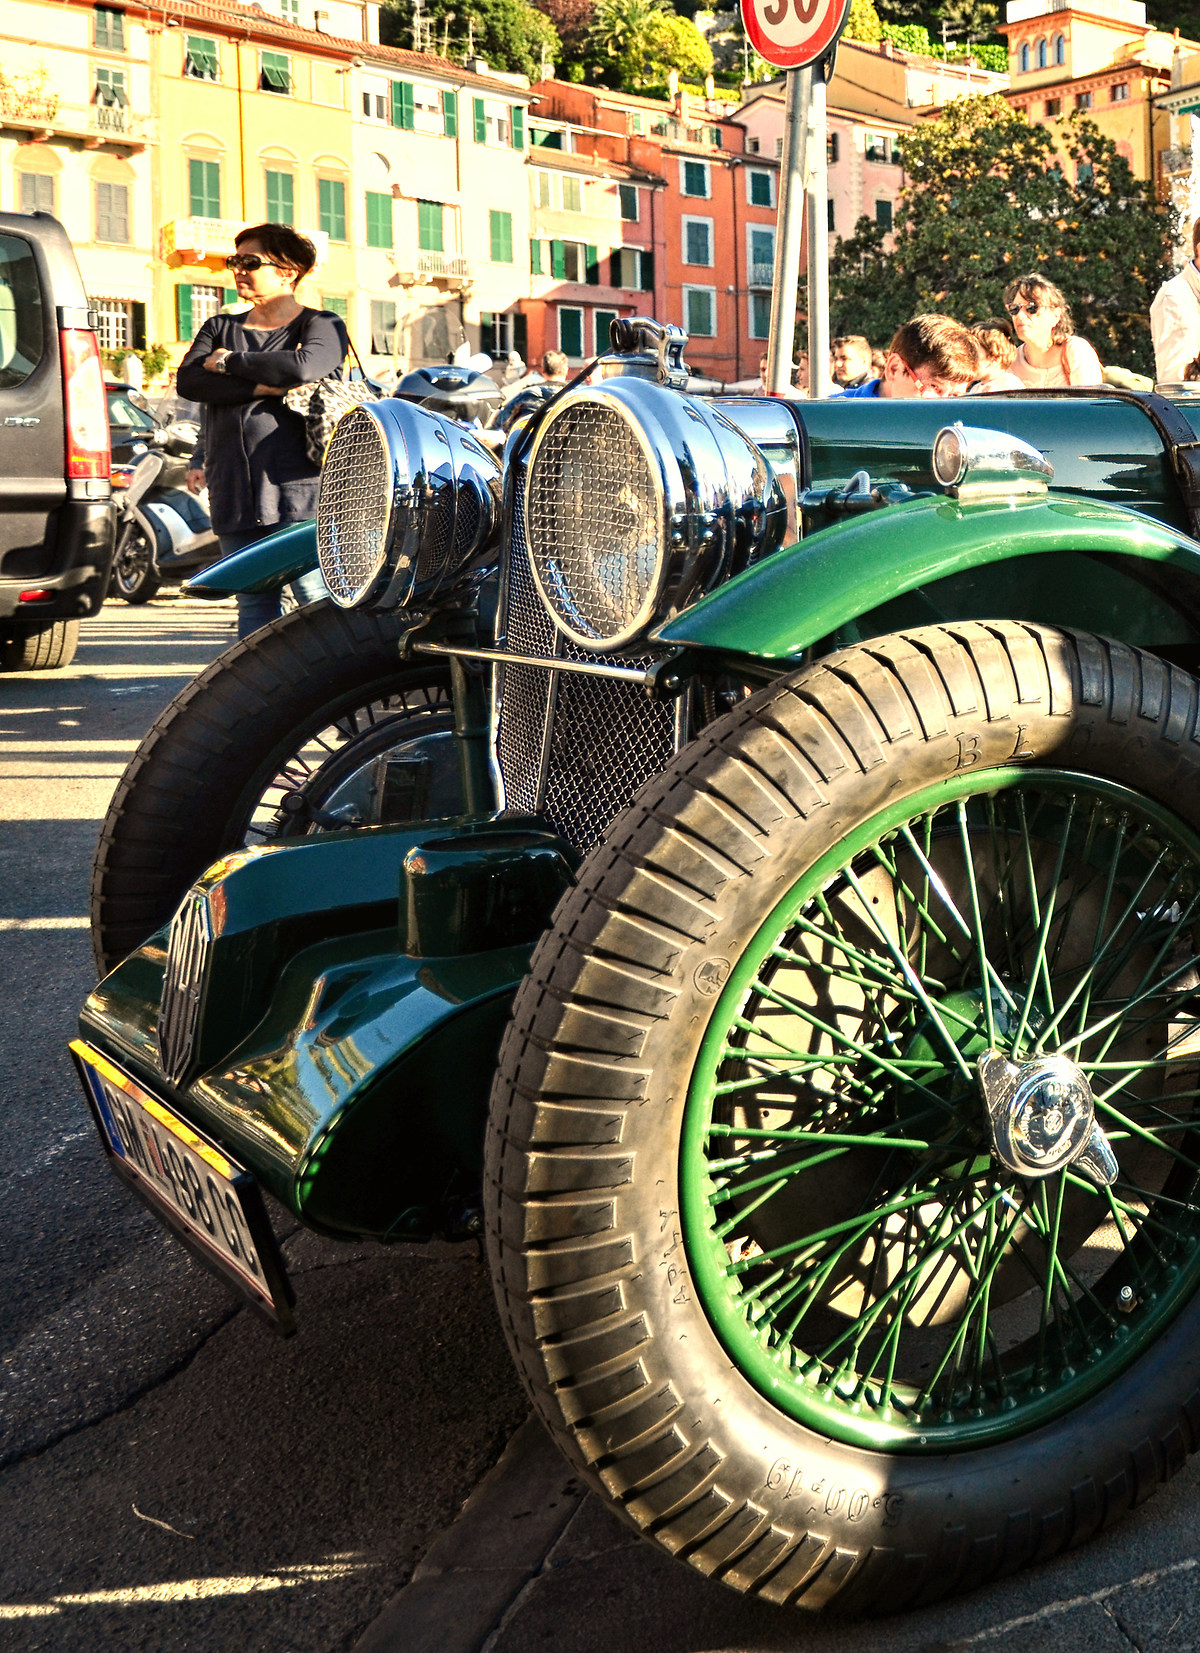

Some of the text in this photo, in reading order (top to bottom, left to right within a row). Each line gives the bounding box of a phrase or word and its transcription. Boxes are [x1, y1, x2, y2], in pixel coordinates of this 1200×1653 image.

[103, 1082, 261, 1277] GM 498 CC
